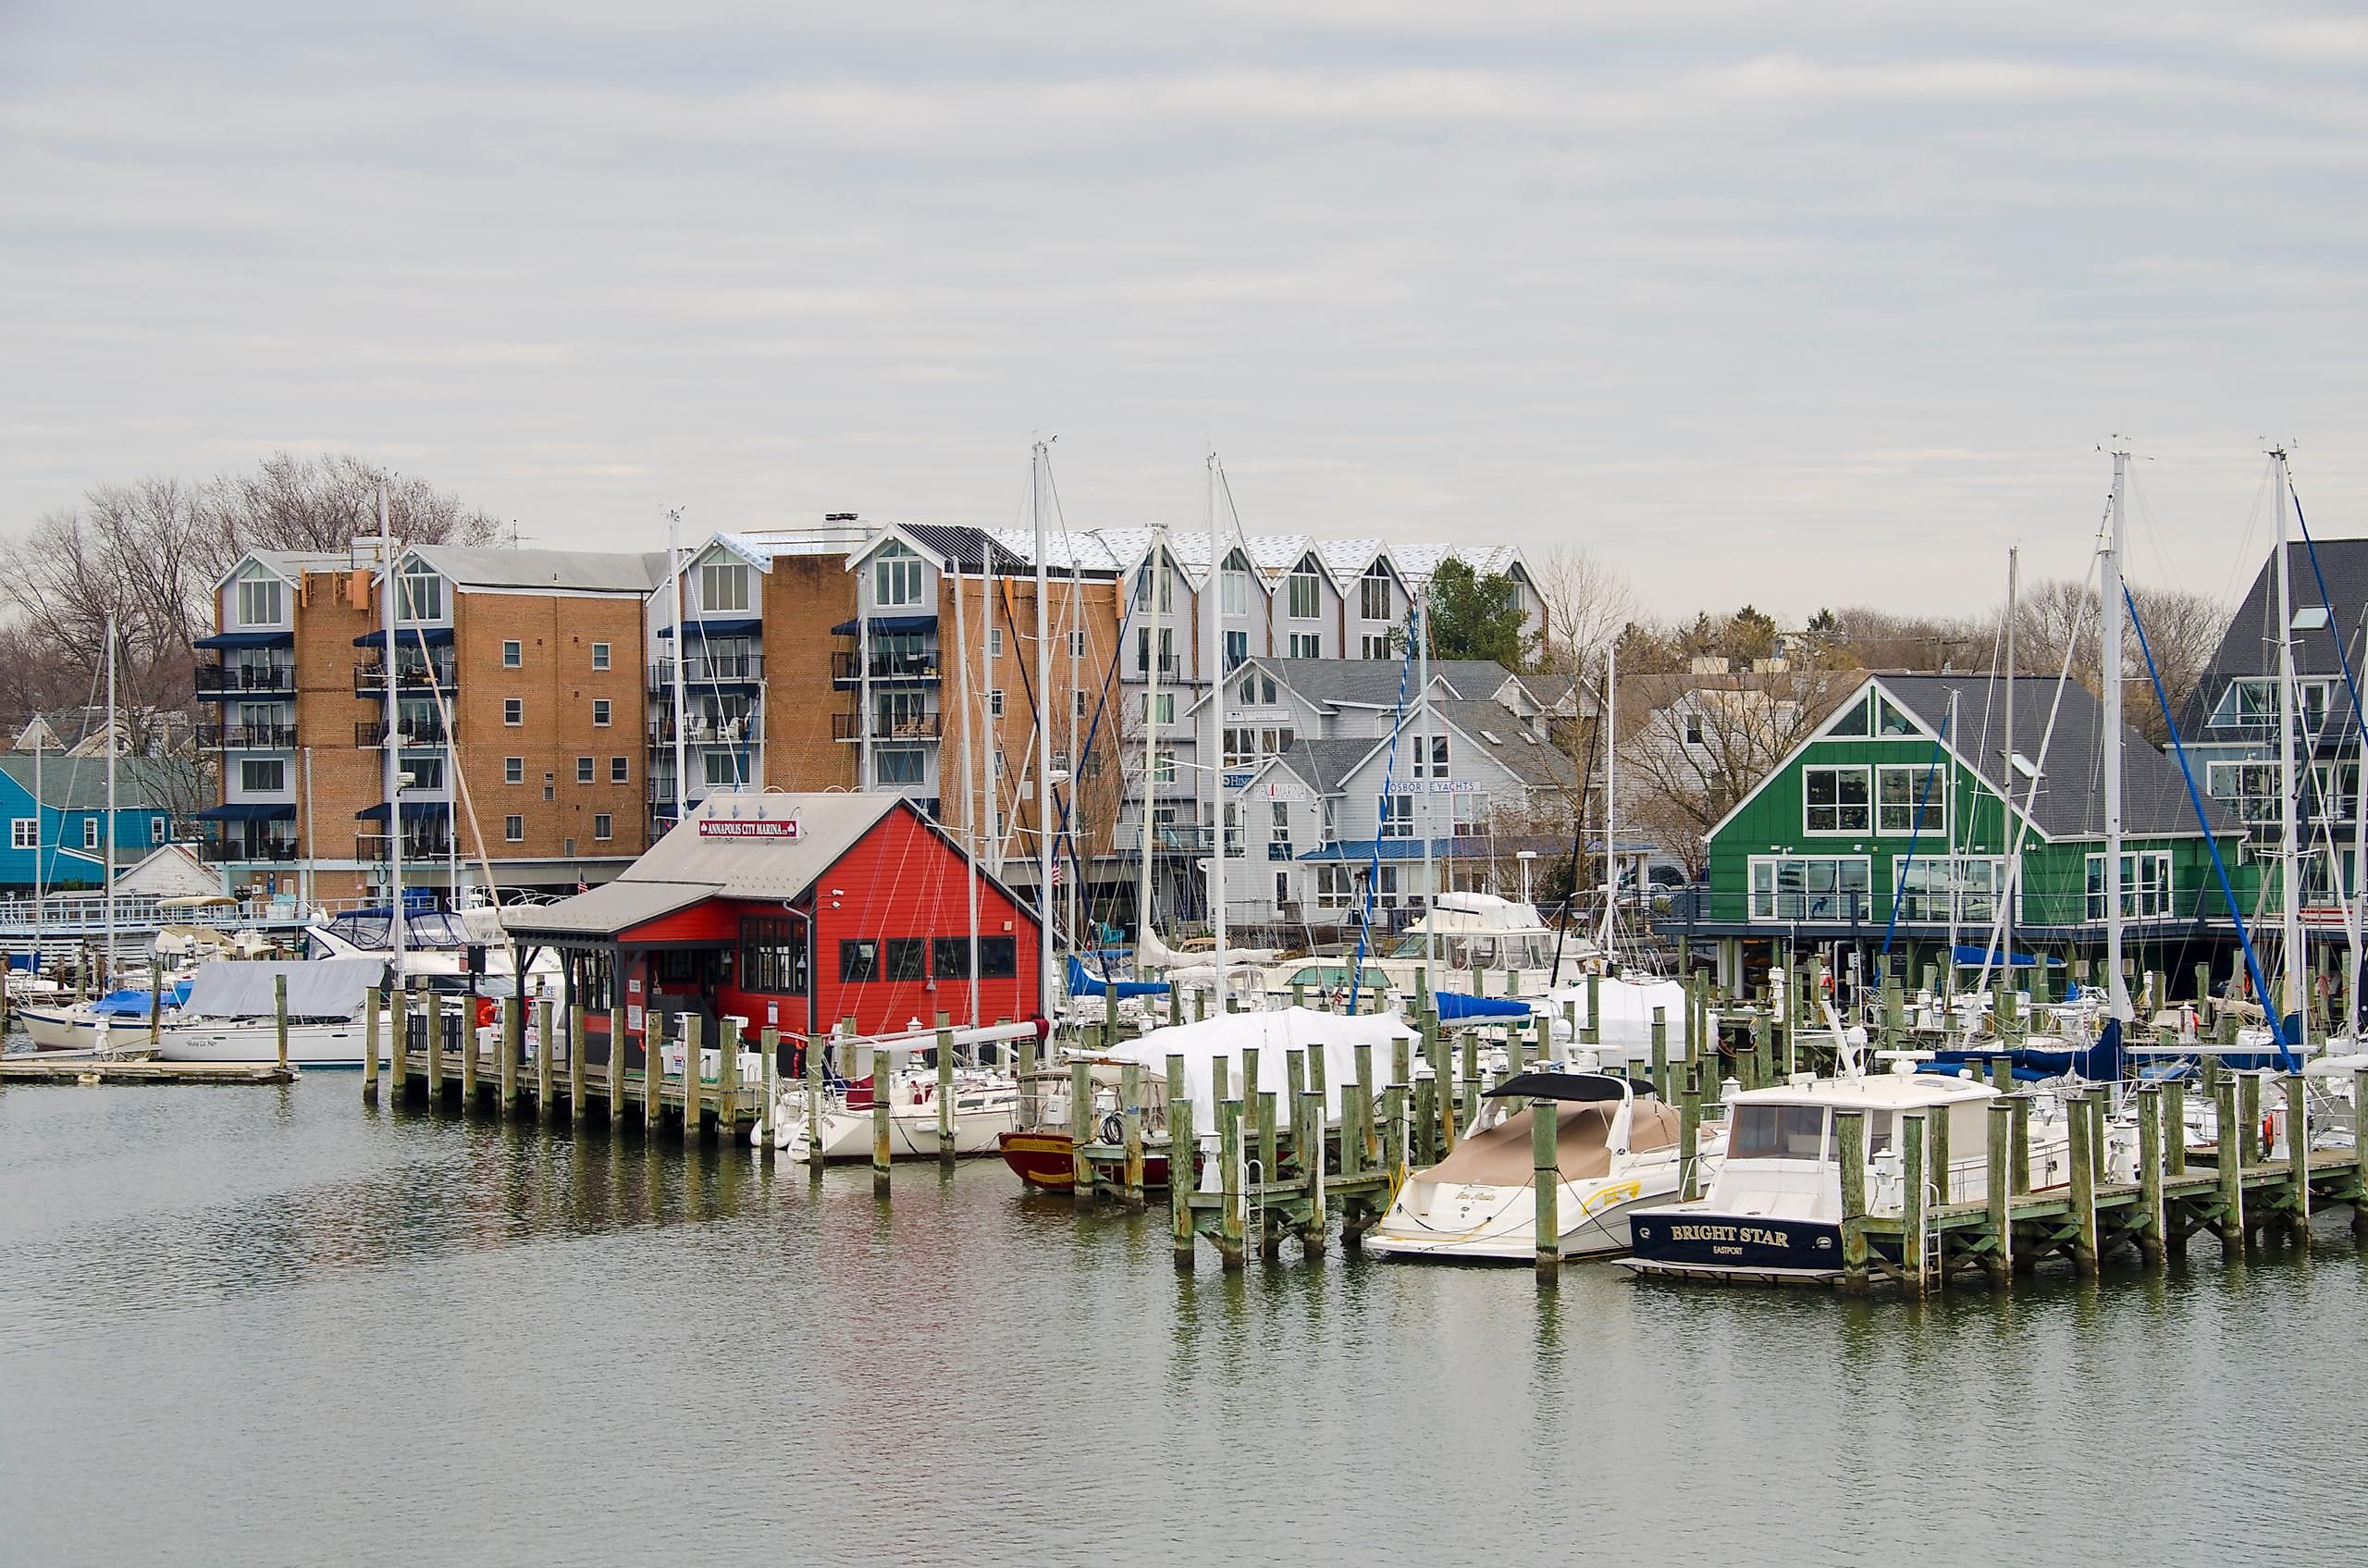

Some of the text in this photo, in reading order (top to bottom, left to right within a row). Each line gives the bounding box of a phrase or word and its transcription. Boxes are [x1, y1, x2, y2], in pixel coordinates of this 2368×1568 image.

[1389, 782, 1474, 792] OSBORE YACHTS
[709, 823, 741, 834] ANNAPOLIS
[742, 823, 756, 834] CITY
[757, 823, 782, 834] MARINA
[1671, 1226, 1790, 1247] BRIGHT STAR
[1713, 1246, 1743, 1255] EASTPORT
